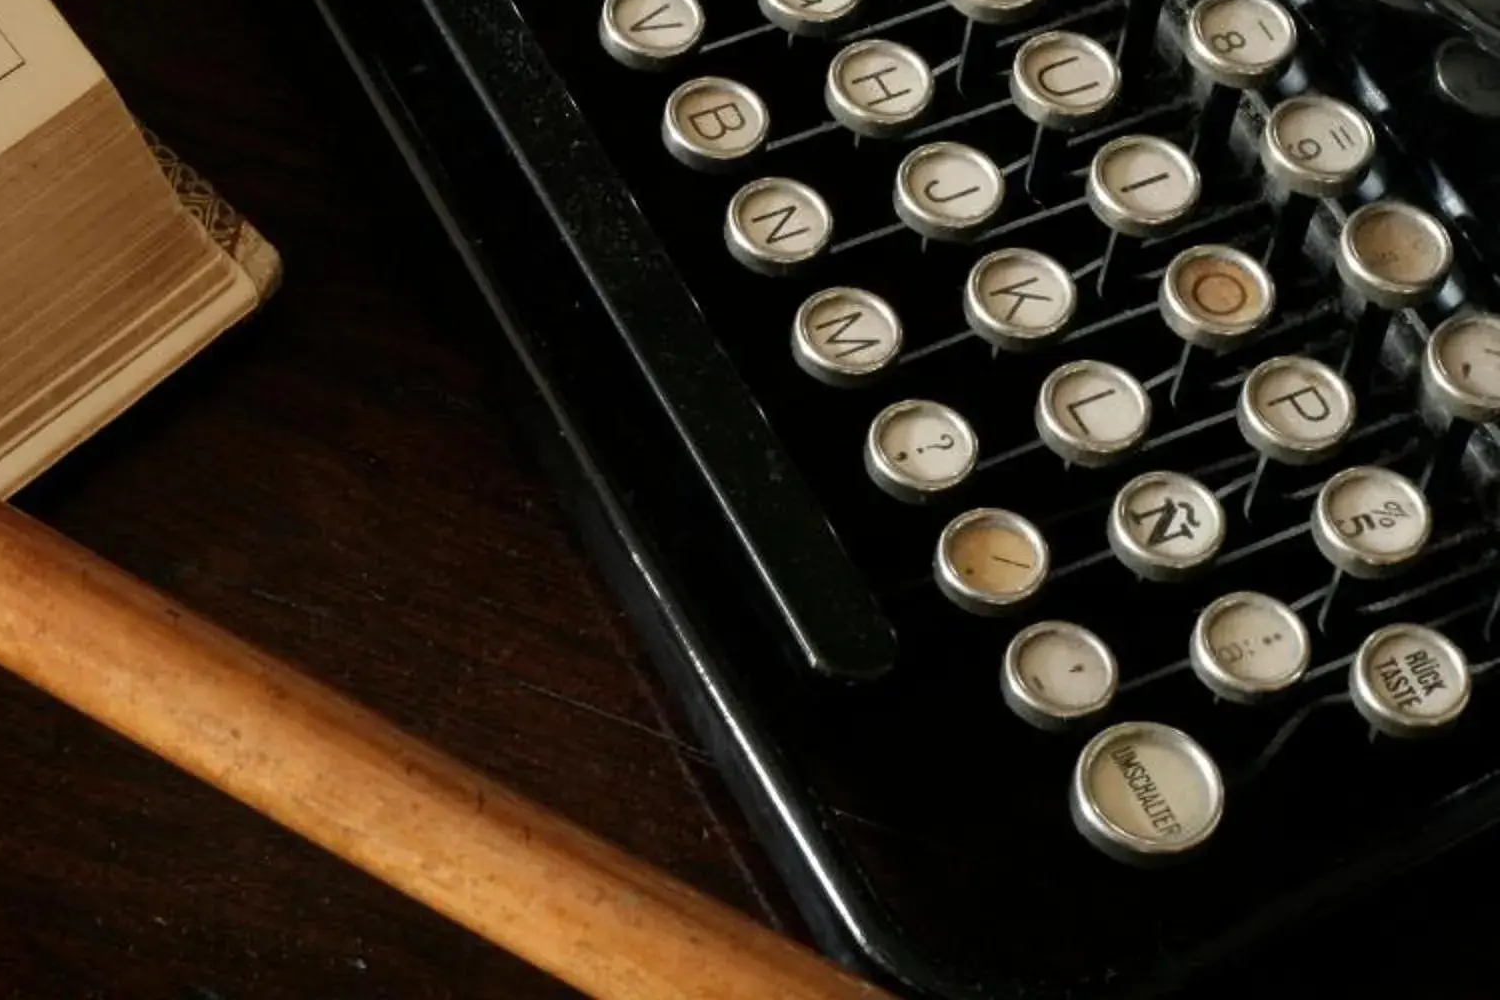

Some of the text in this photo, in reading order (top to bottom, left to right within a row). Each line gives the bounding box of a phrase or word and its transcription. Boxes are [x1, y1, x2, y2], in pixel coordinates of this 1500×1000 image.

[629, 2, 684, 36] V
[1210, 30, 1247, 55] 8
[850, 65, 912, 107] H
[1036, 55, 1102, 99] U
[686, 101, 747, 141] B
[1286, 141, 1323, 161] 9
[923, 176, 982, 206] J
[1120, 171, 1172, 195] I
[750, 203, 813, 247] N
[988, 275, 1054, 321] K
[1191, 272, 1249, 316] O
[814, 310, 883, 360] M
[1067, 388, 1117, 436] L
[1267, 384, 1332, 422] P
[1129, 494, 1202, 546] Ñ
[1335, 513, 1378, 538] 5
[1376, 658, 1424, 711] TASTE
[1404, 647, 1451, 695] RÜCK
[1108, 743, 1184, 840] UMSCHALTER
